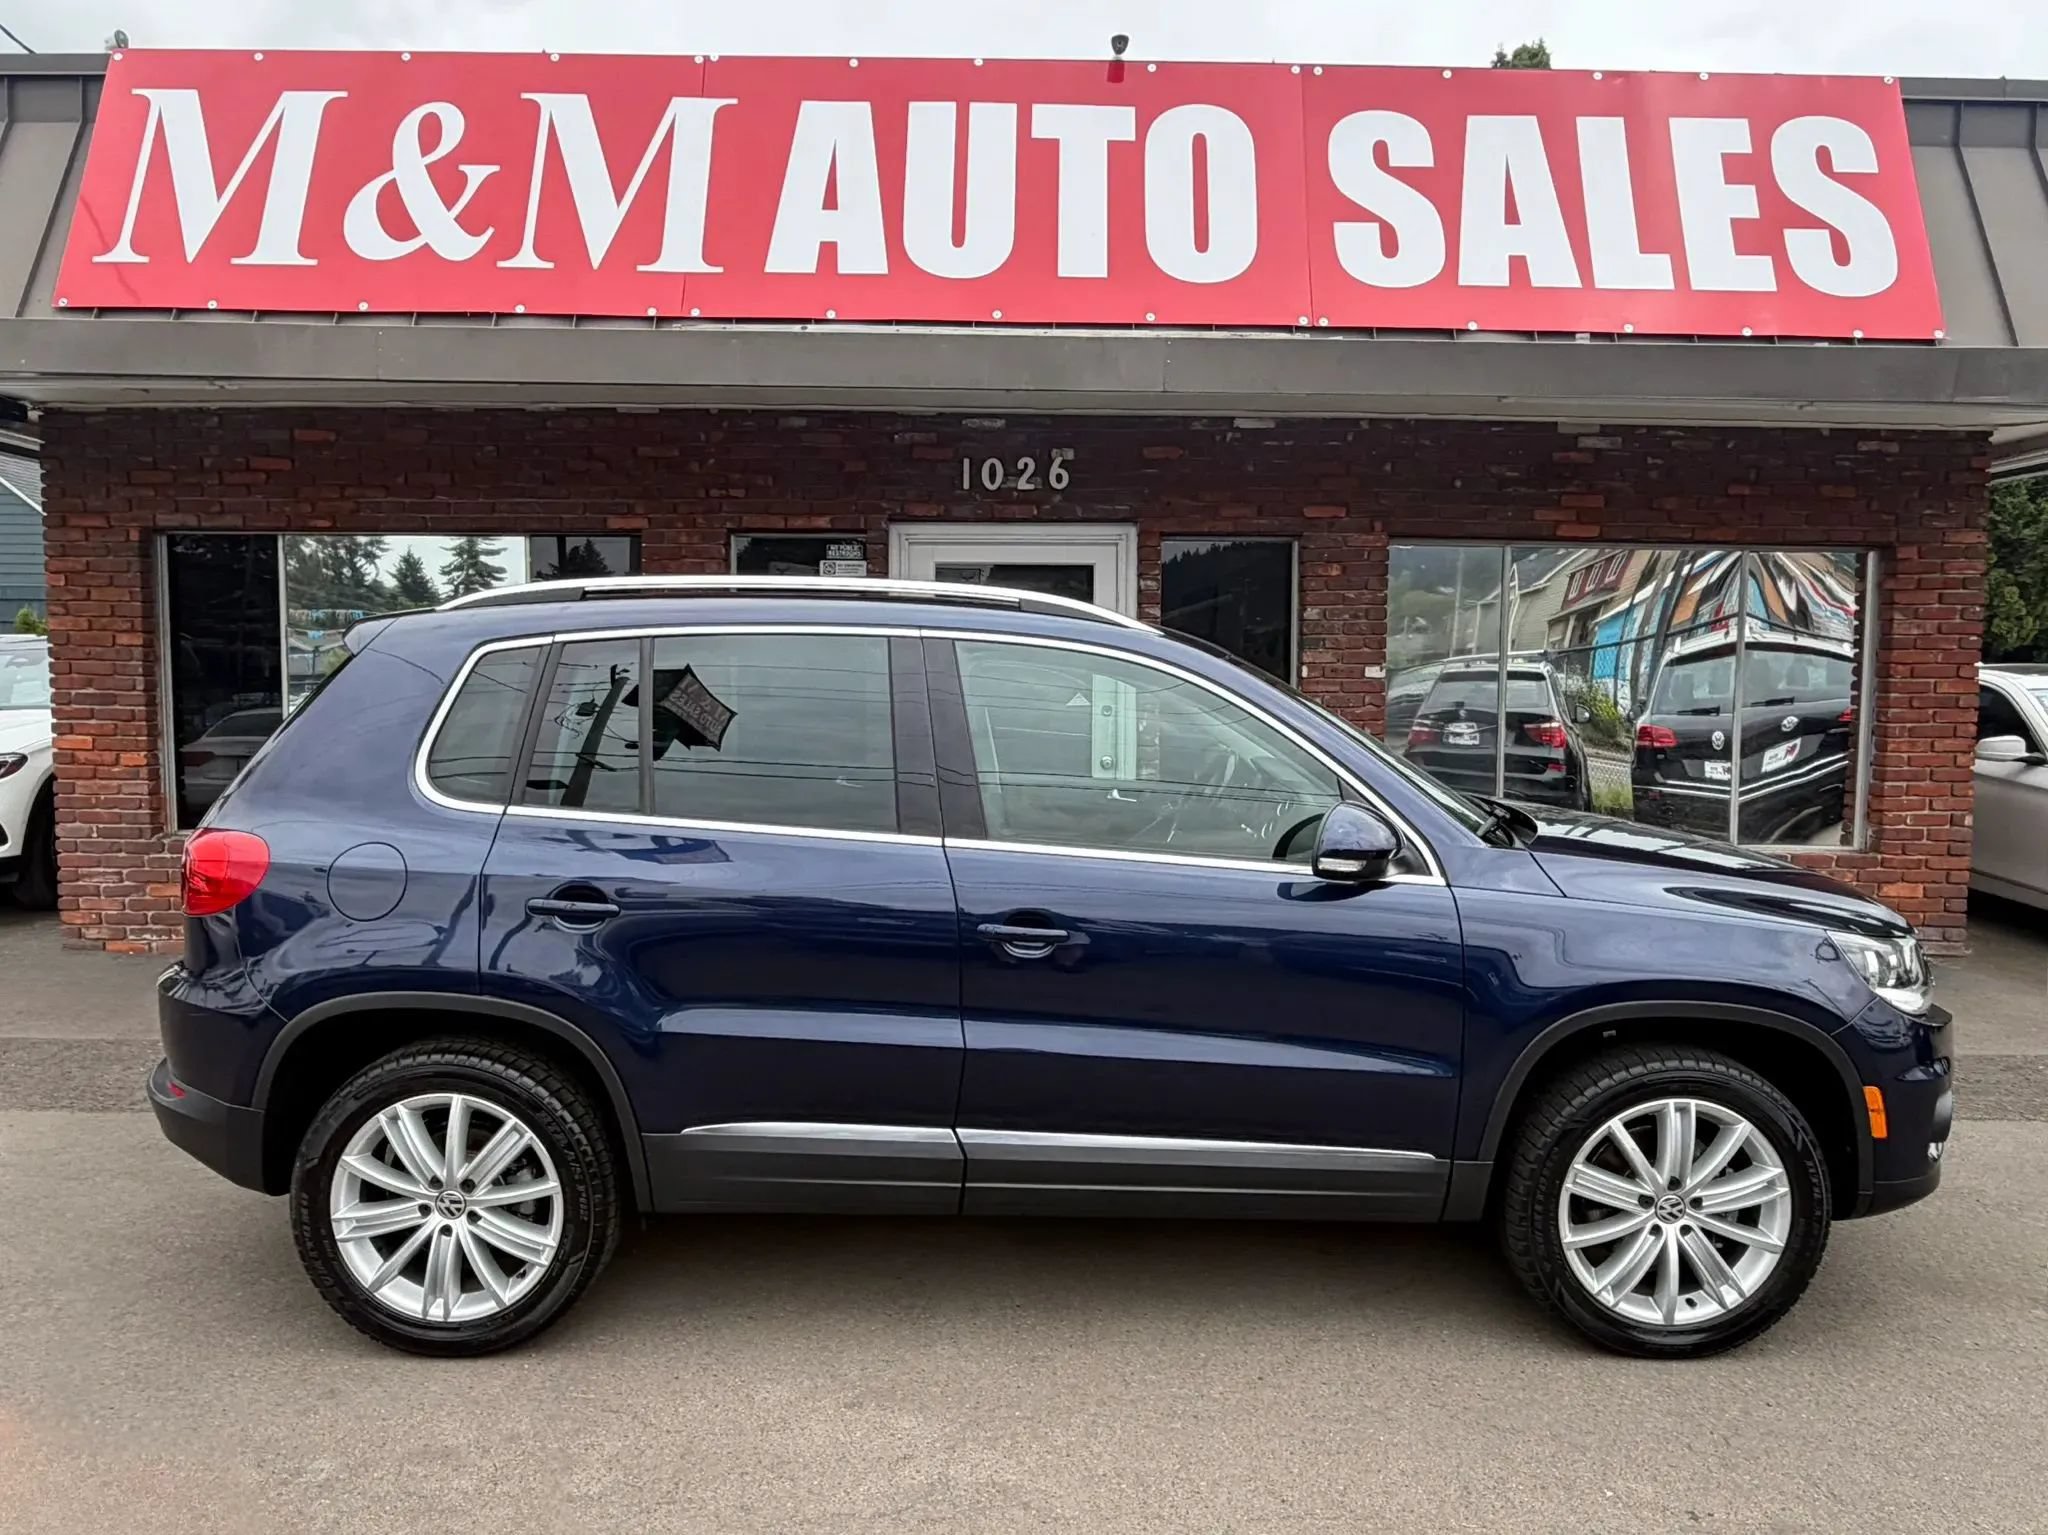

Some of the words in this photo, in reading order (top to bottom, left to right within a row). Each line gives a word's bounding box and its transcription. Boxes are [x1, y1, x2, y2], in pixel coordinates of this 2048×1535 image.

[92, 88, 739, 274] M&M
[764, 100, 1257, 285] AUTO
[1327, 110, 1899, 298] SALES
[962, 456, 1070, 491] 1026
